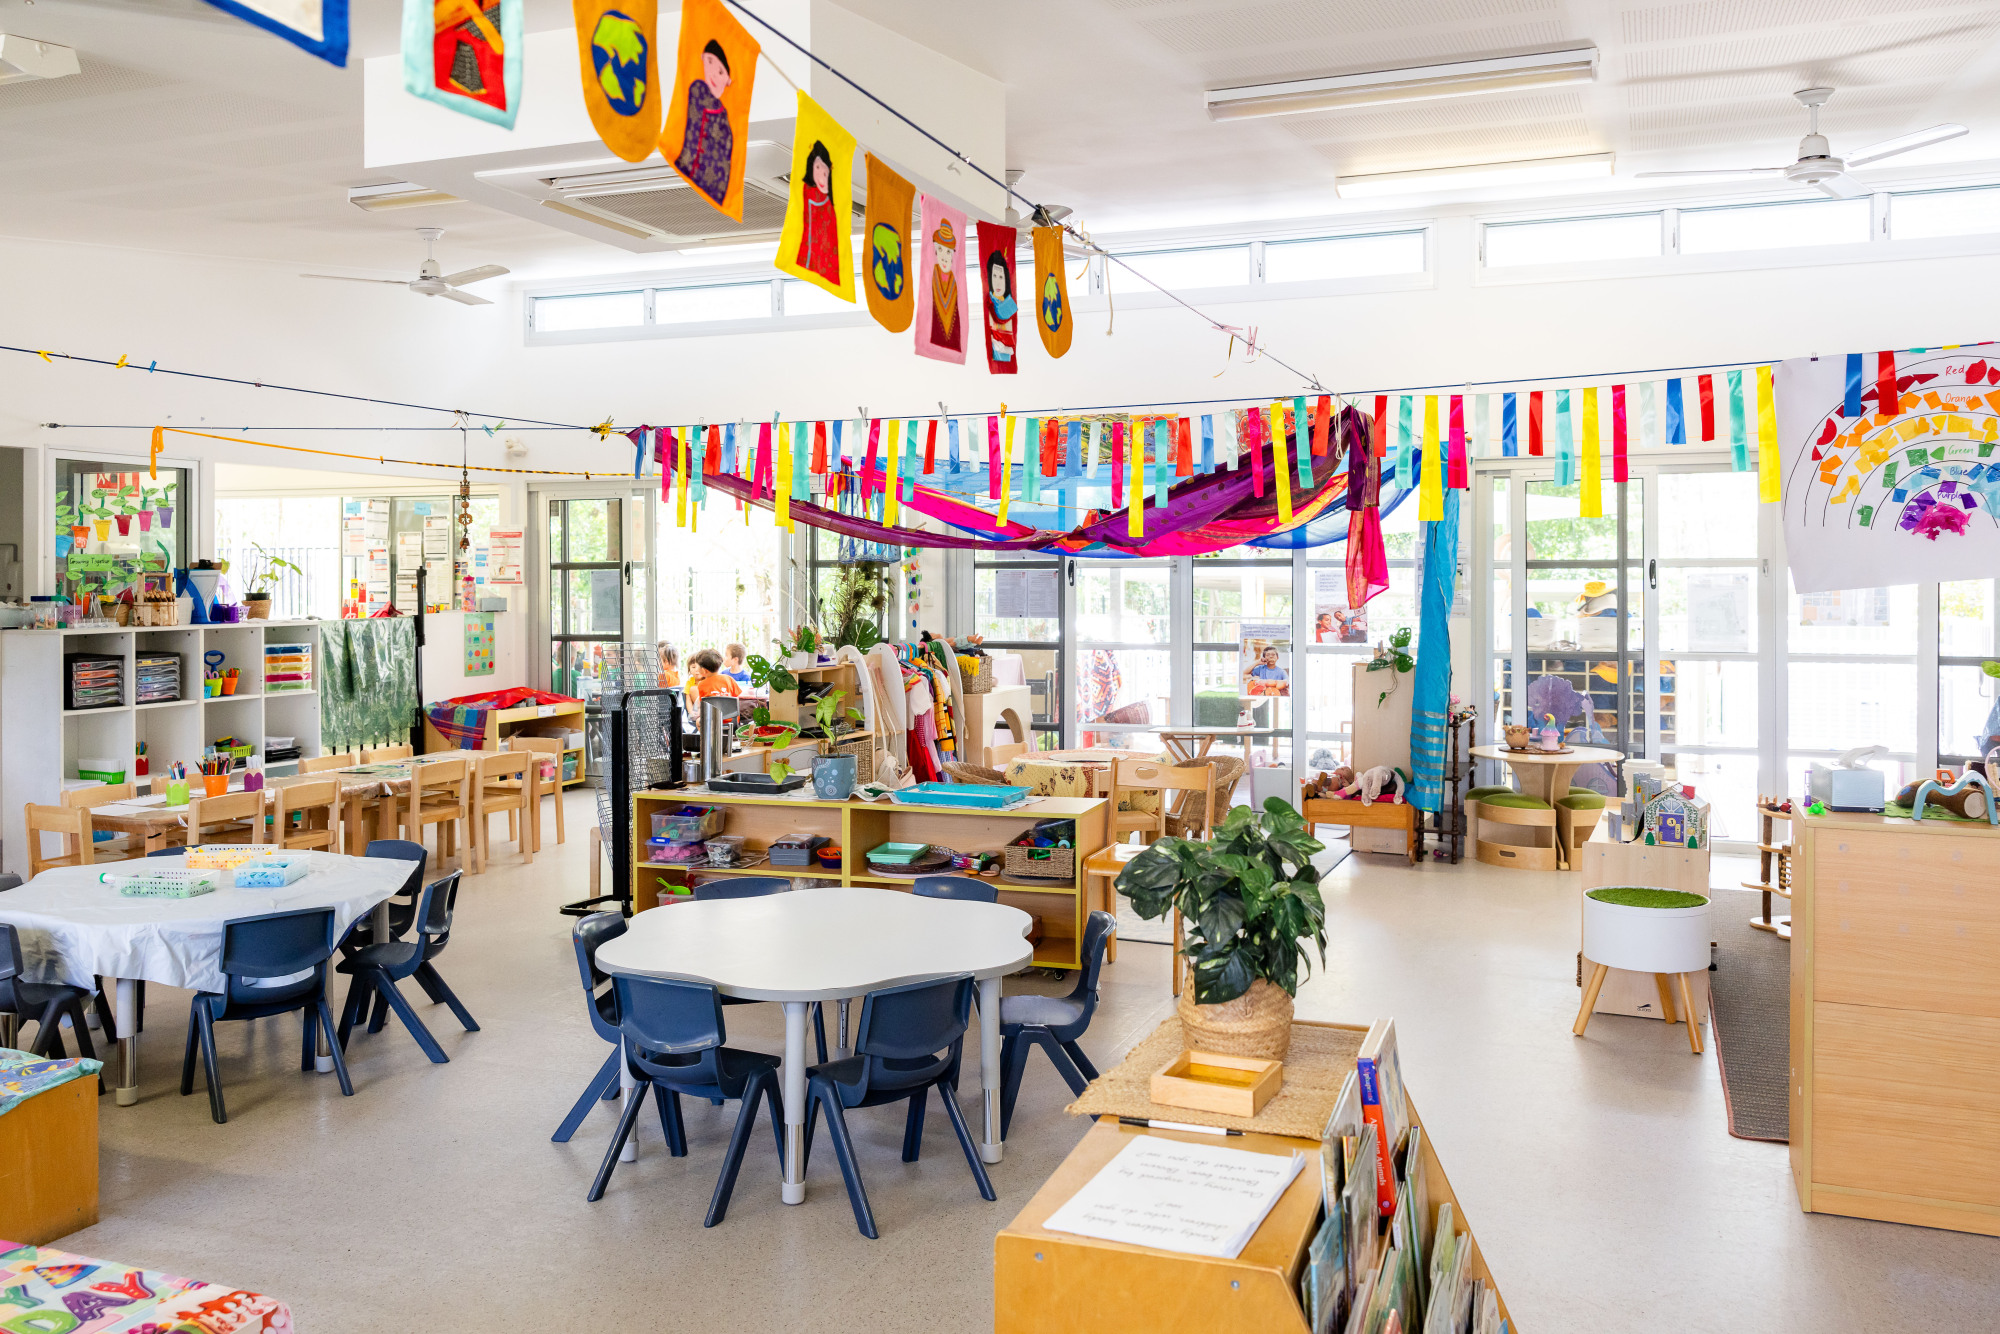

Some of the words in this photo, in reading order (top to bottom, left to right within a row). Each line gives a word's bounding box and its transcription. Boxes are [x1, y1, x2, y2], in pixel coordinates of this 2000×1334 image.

[1945, 364, 1965, 376] Red
[1945, 392, 1975, 408] Orang
[1948, 444, 1974, 455] Green
[1950, 466, 1968, 476] Blue
[1376, 1156, 1387, 1186] Animals
